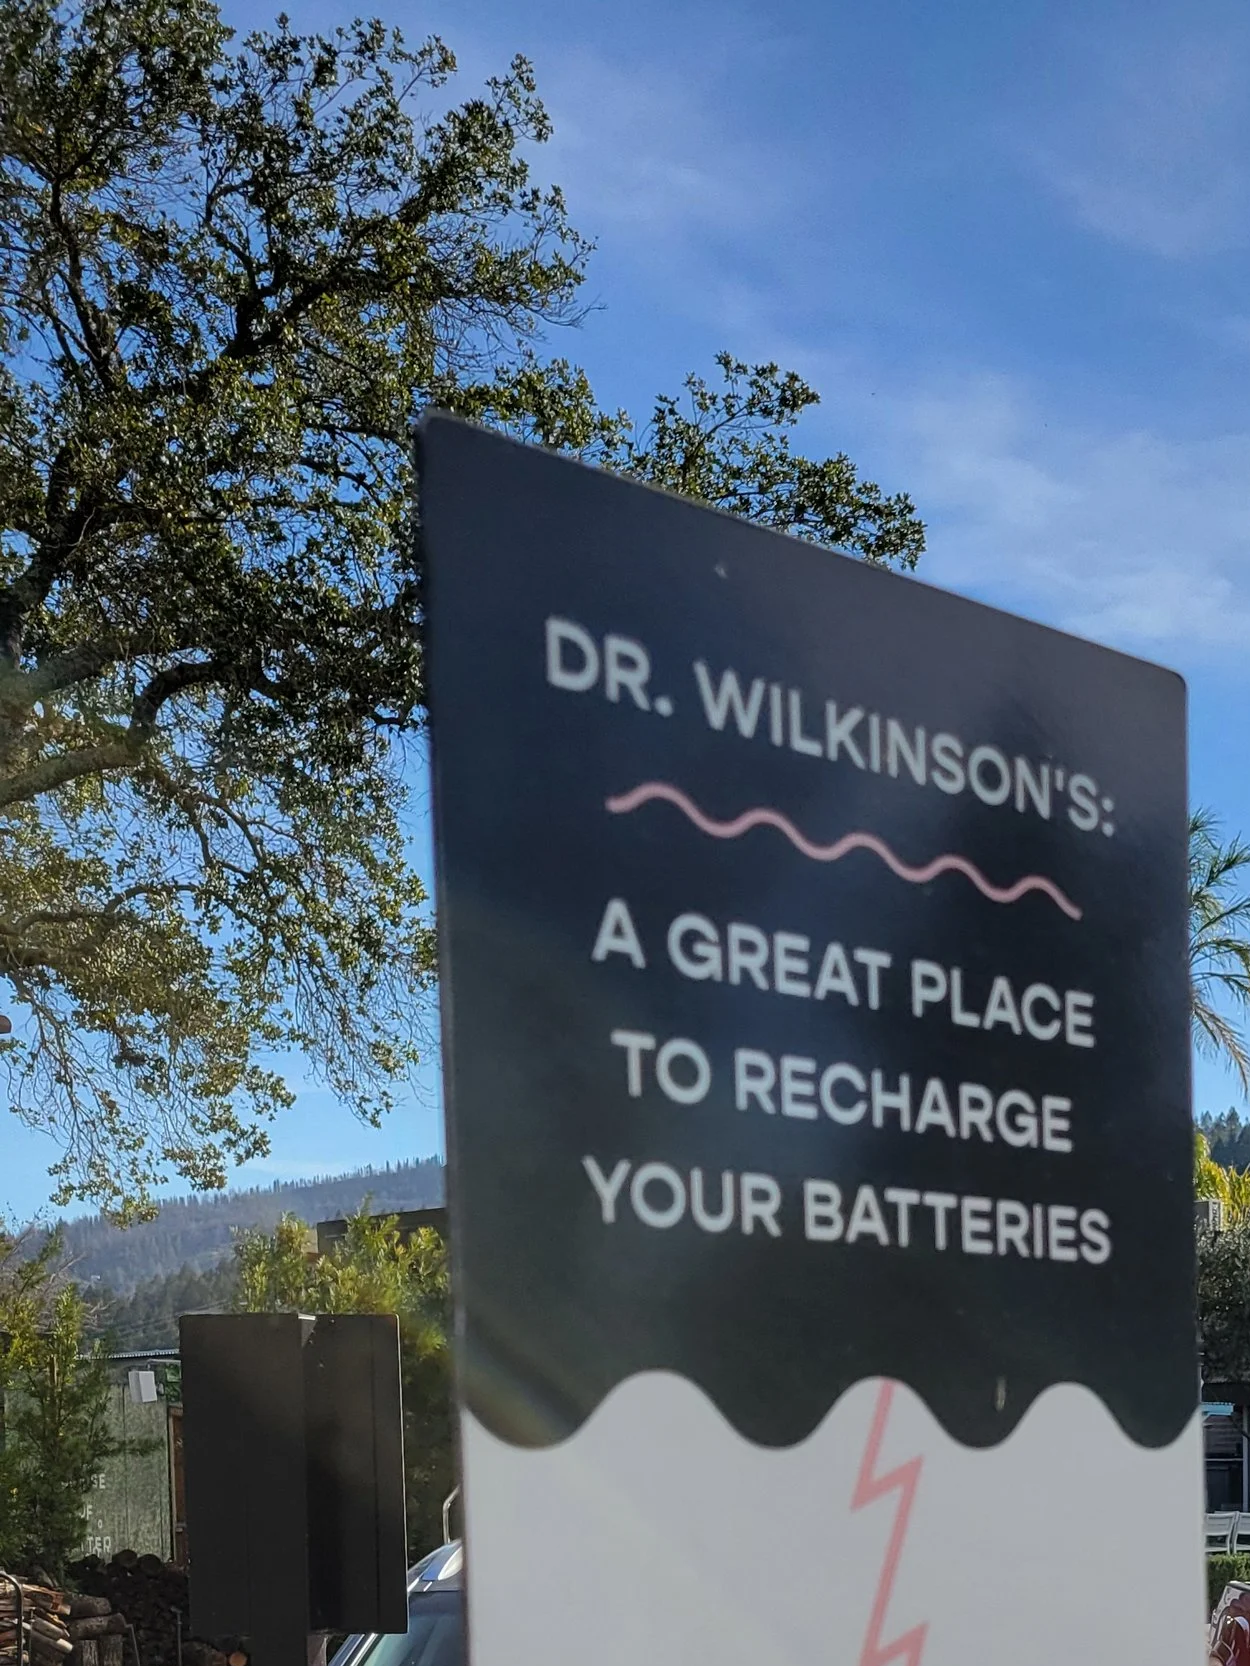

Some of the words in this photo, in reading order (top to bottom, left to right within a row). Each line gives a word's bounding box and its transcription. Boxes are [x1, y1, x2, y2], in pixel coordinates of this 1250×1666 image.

[545, 615, 672, 717] DR.
[693, 660, 1116, 837] WILKINSON'S:
[591, 898, 646, 969] A
[667, 912, 891, 1012] GREAT
[910, 959, 1096, 1048] PLACE
[610, 1029, 711, 1103] TO
[733, 1048, 1073, 1154] RECHARGE
[581, 1155, 782, 1237] YOUR
[802, 1179, 1112, 1265] BATTERIES
